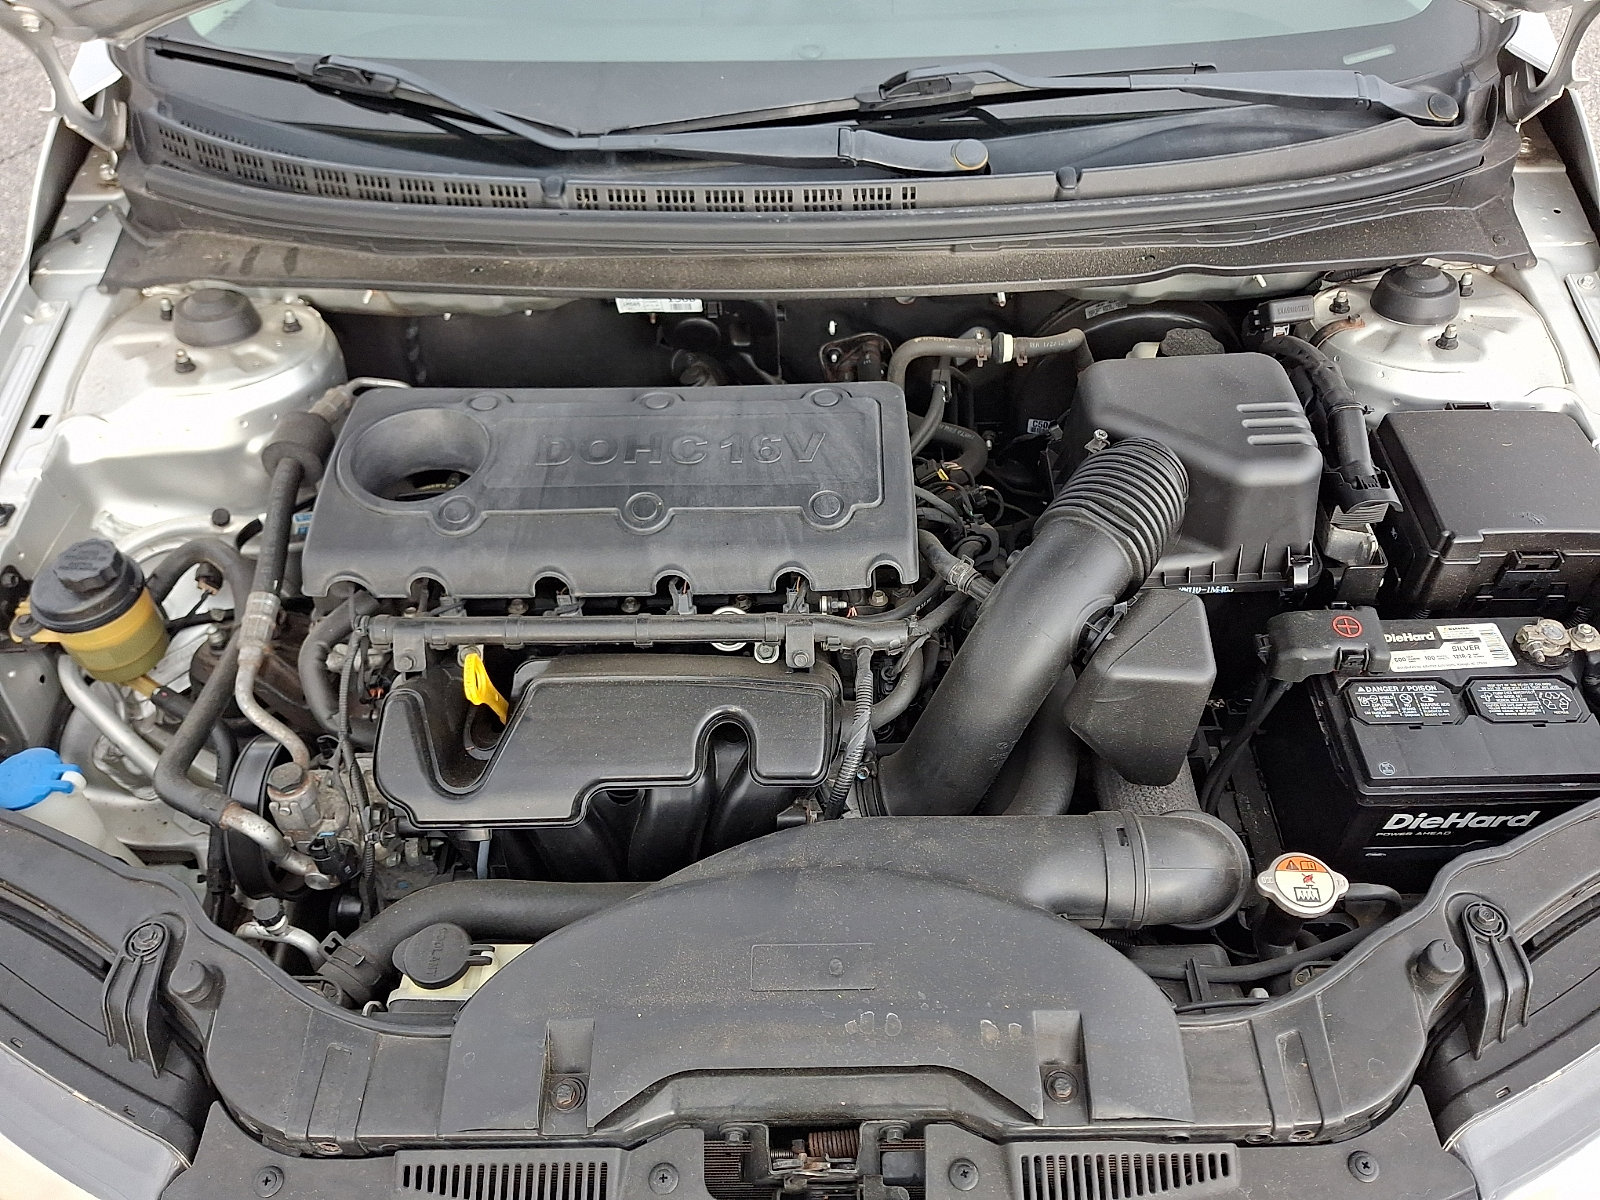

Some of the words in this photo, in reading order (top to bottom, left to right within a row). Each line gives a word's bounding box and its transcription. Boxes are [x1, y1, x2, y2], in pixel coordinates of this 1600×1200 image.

[535, 433, 708, 466] DOHC
[719, 432, 826, 464] 16V
[1383, 631, 1436, 643] DieHard
[1451, 644, 1481, 652] SILVER
[1365, 684, 1400, 693] DANGER
[1406, 684, 1438, 692] POISON
[1382, 810, 1541, 830] DieHard
